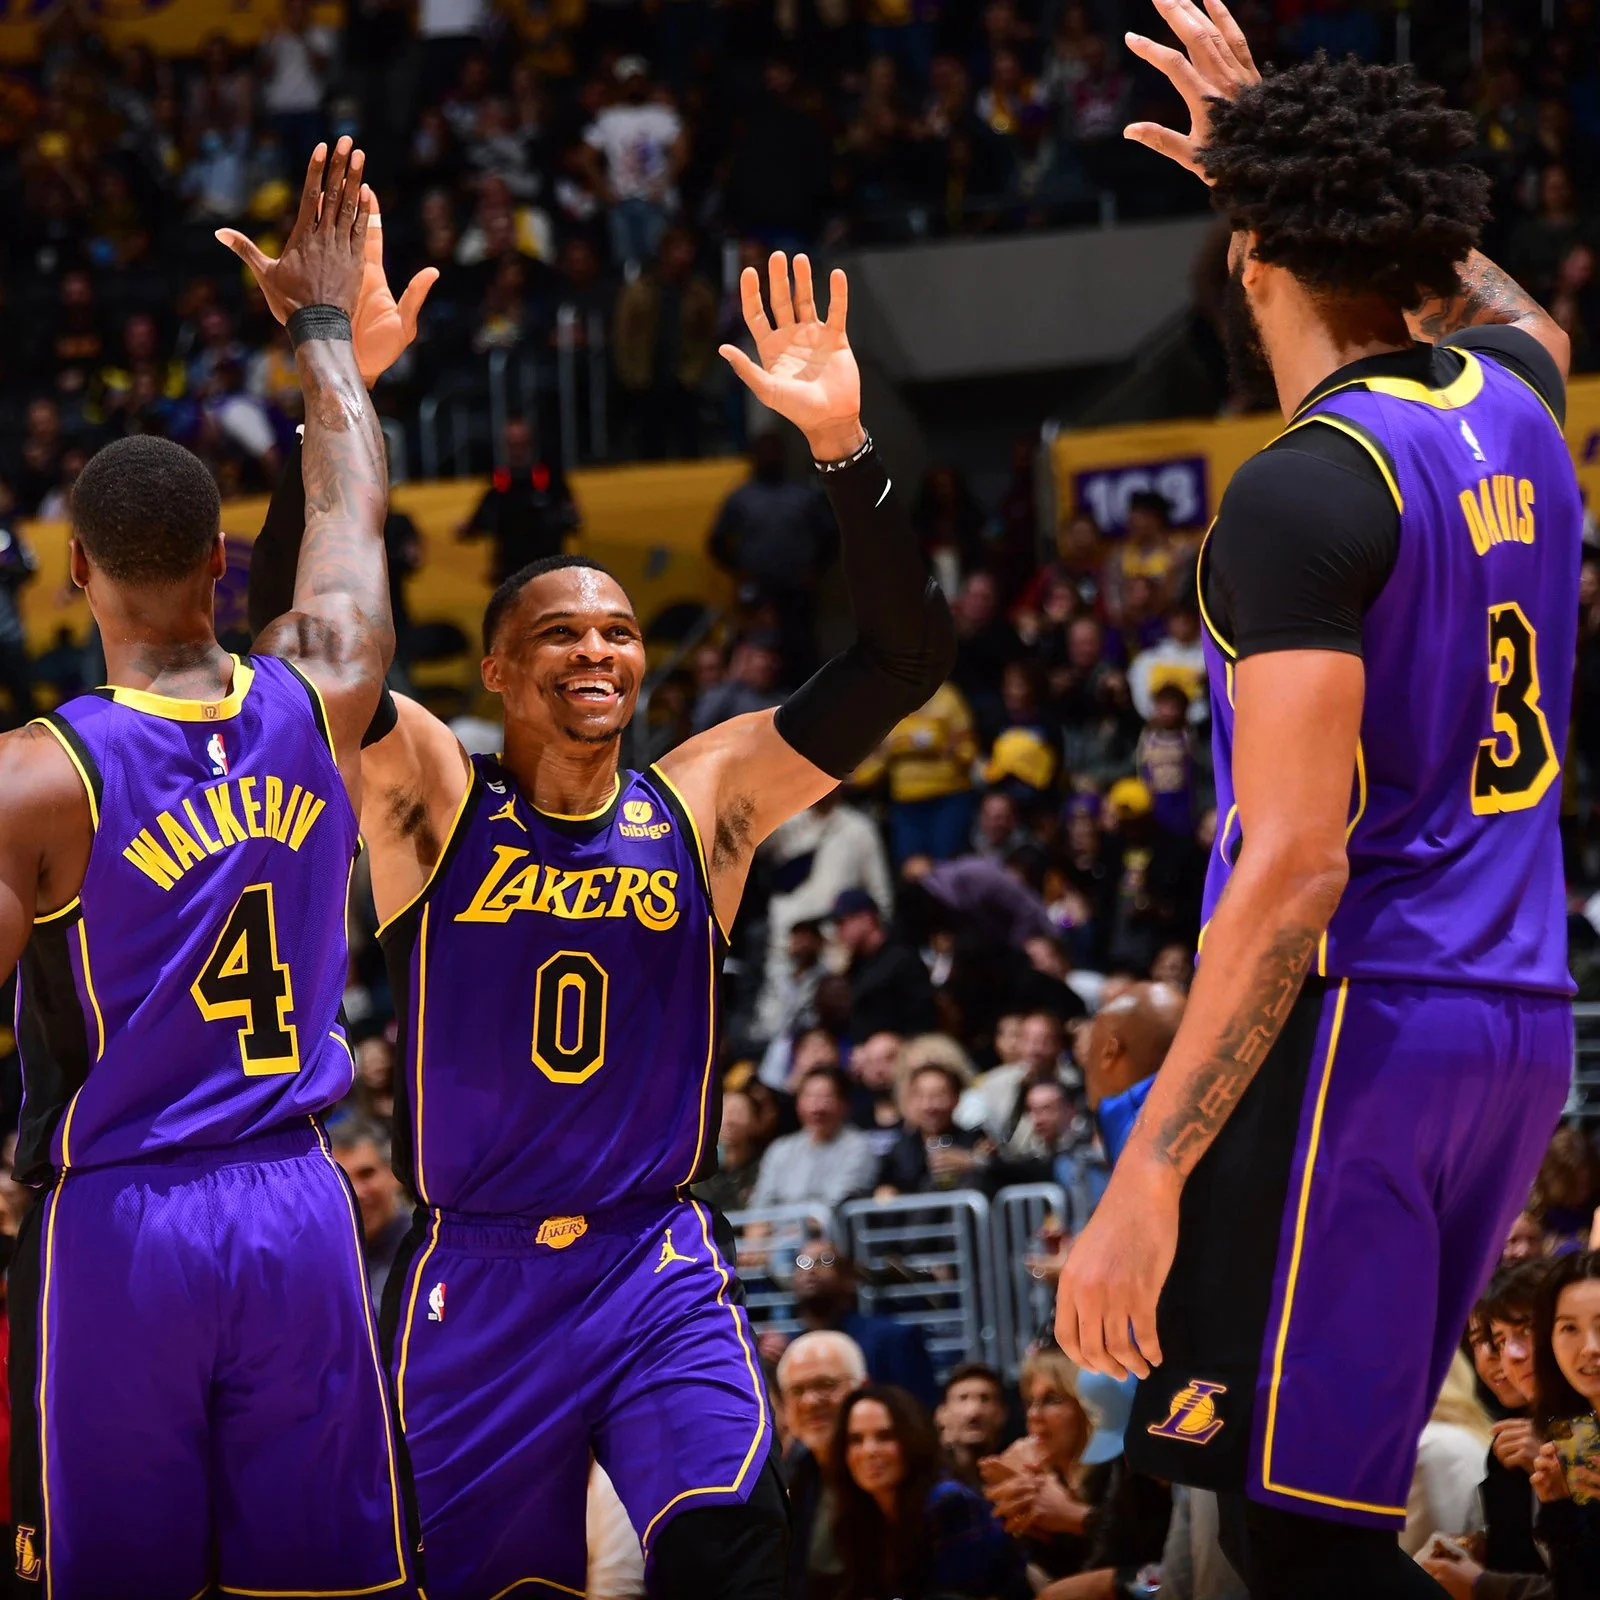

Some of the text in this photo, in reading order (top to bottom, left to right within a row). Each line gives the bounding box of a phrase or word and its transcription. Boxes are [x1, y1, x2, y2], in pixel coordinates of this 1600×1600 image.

[1458, 474, 1536, 556] DAVIS
[1470, 601, 1561, 816] 3
[618, 822, 671, 840] bibigo
[453, 844, 680, 931] LAKERS
[189, 882, 300, 1076] 4
[531, 950, 609, 1085] 0
